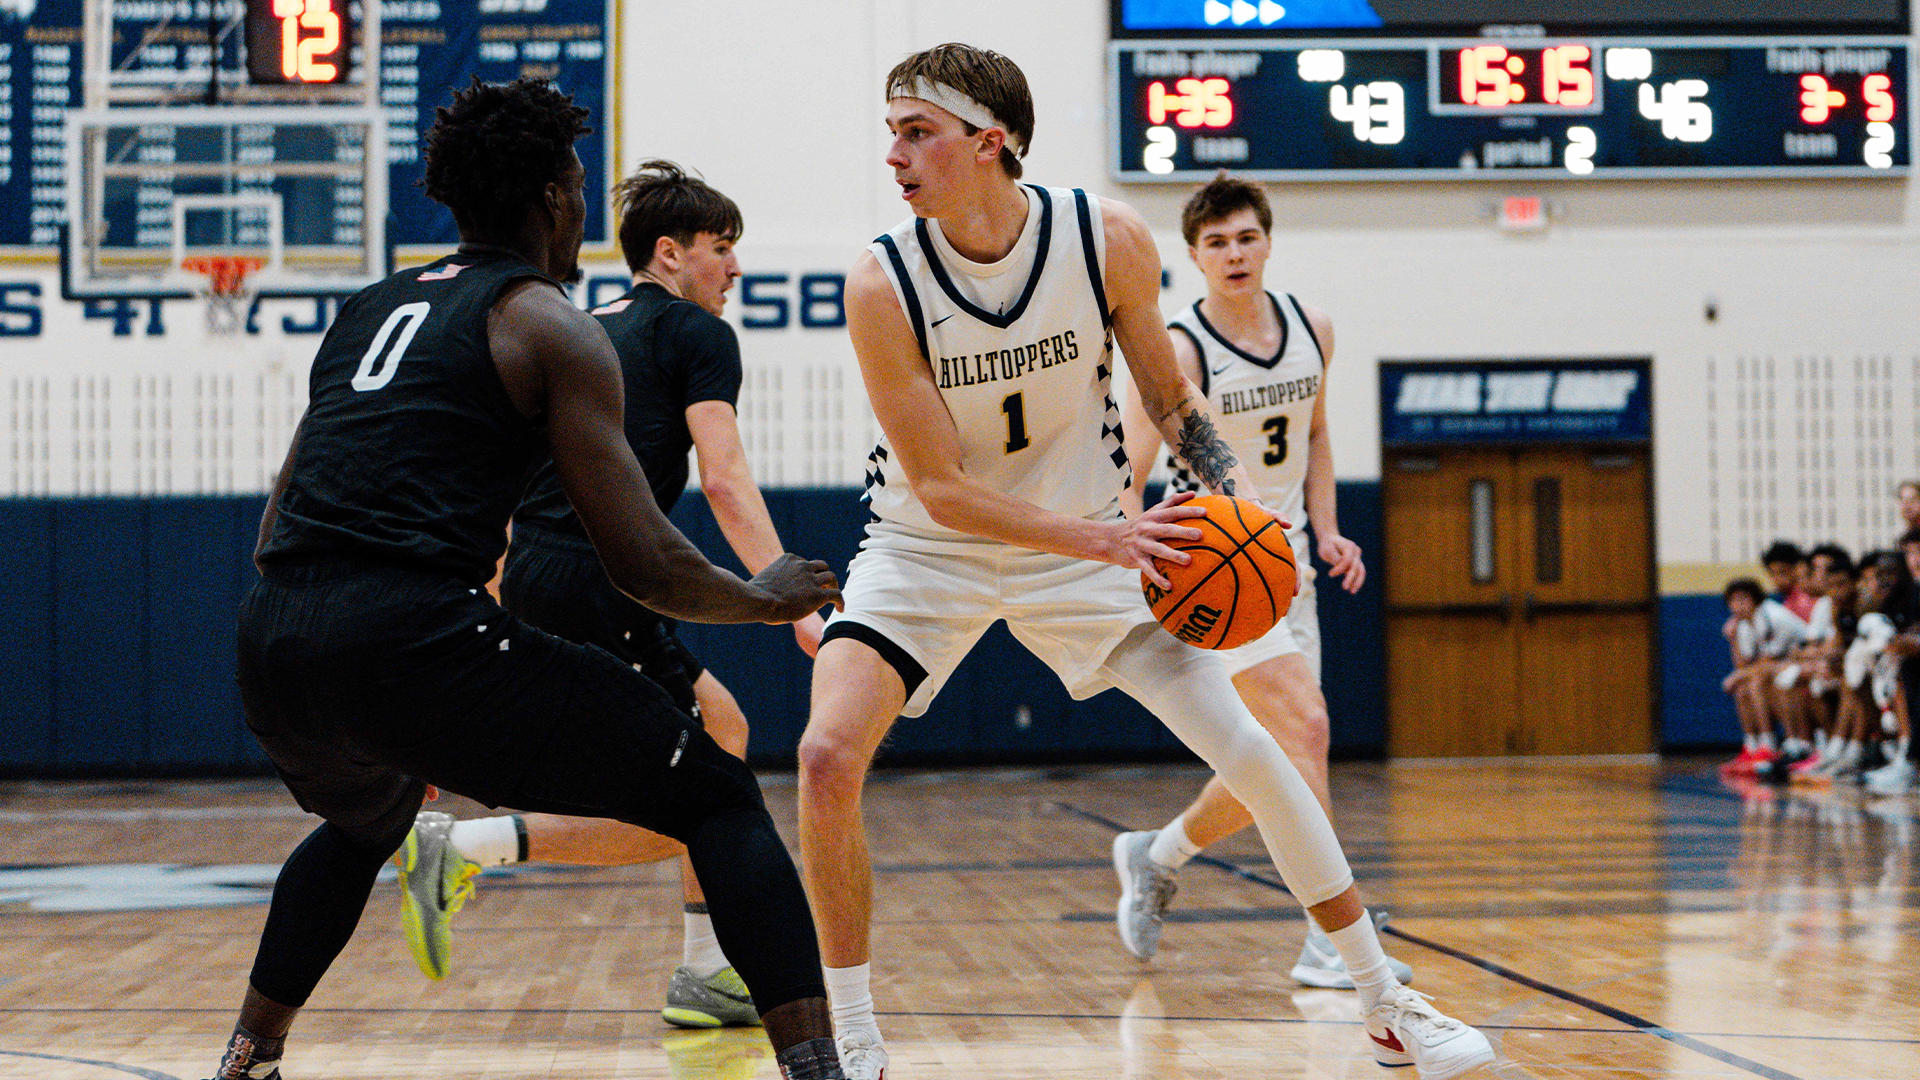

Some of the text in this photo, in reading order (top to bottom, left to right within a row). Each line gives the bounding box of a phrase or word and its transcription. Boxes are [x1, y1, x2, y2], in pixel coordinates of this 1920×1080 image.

[282, 11, 339, 82] 12
[1330, 82, 1405, 144] 43
[1638, 80, 1712, 142] 46
[1143, 126, 1177, 174] 2
[1483, 138, 1551, 168] period
[1564, 126, 1597, 175] 2
[1863, 121, 1895, 168] 2
[742, 275, 846, 328] 58
[352, 302, 431, 391] 0
[939, 330, 1079, 389] HILLTOPPERS
[1000, 389, 1032, 456] 1
[1262, 415, 1288, 467] 3
